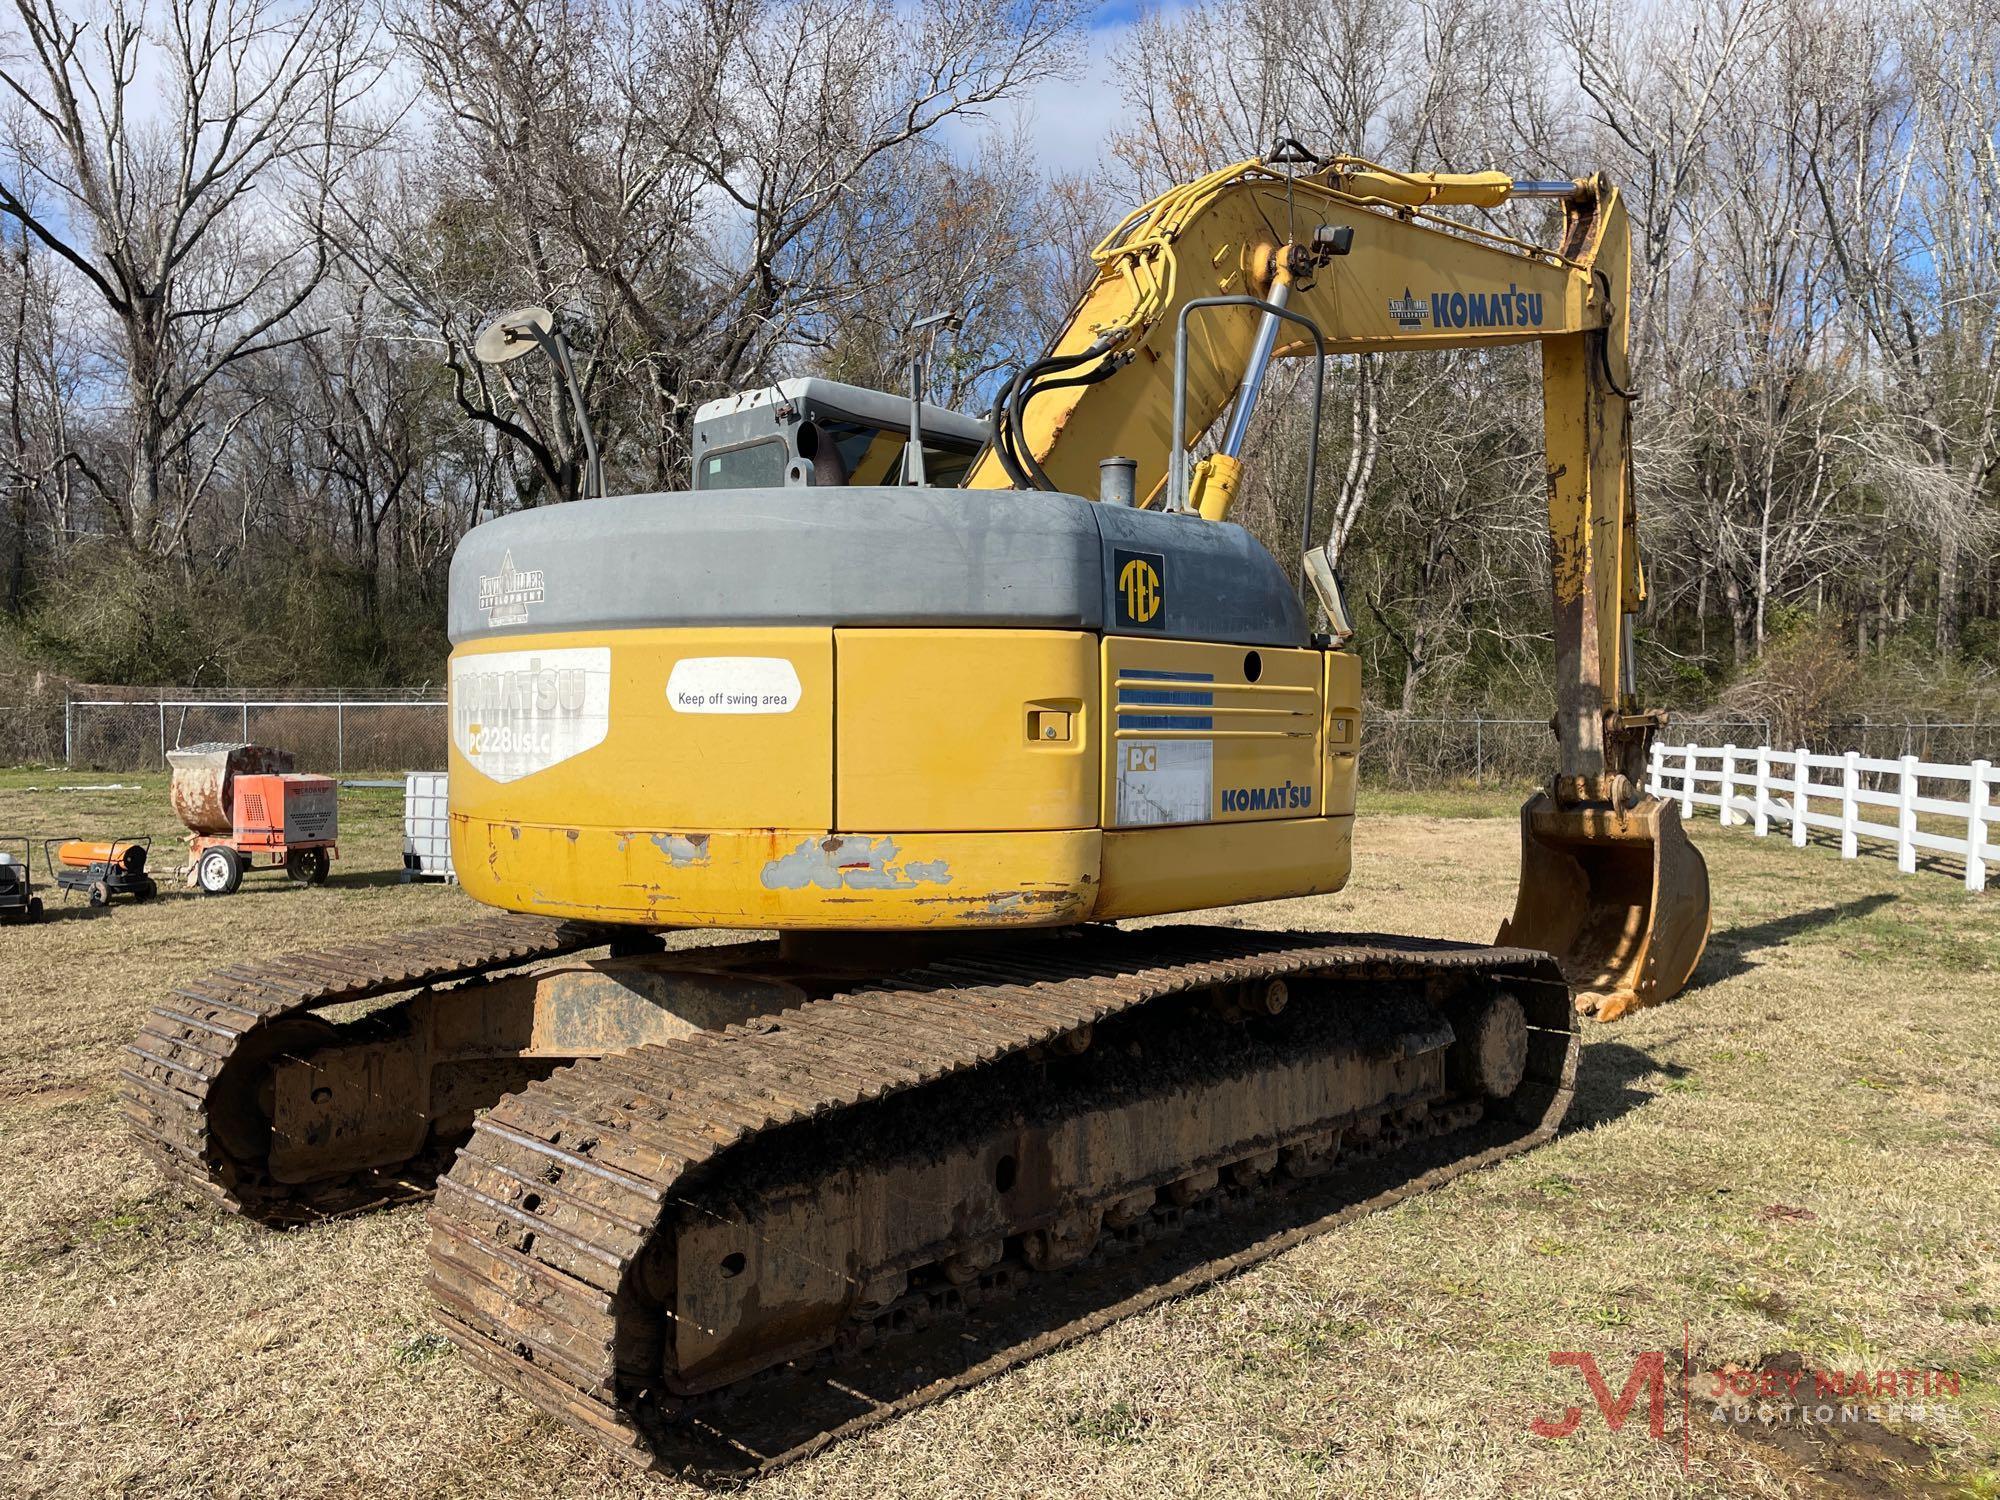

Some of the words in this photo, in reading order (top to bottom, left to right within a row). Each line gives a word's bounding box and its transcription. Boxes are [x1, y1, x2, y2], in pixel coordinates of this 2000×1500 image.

[1431, 283, 1543, 328] KOMATSU
[480, 590, 543, 609] DEVELOPMENT
[678, 693, 705, 707] Keep
[709, 693, 723, 705] off
[727, 693, 758, 707] swing
[762, 695, 787, 705] area
[1131, 748, 1155, 770] PC
[1221, 780, 1311, 812] KOMATSU
